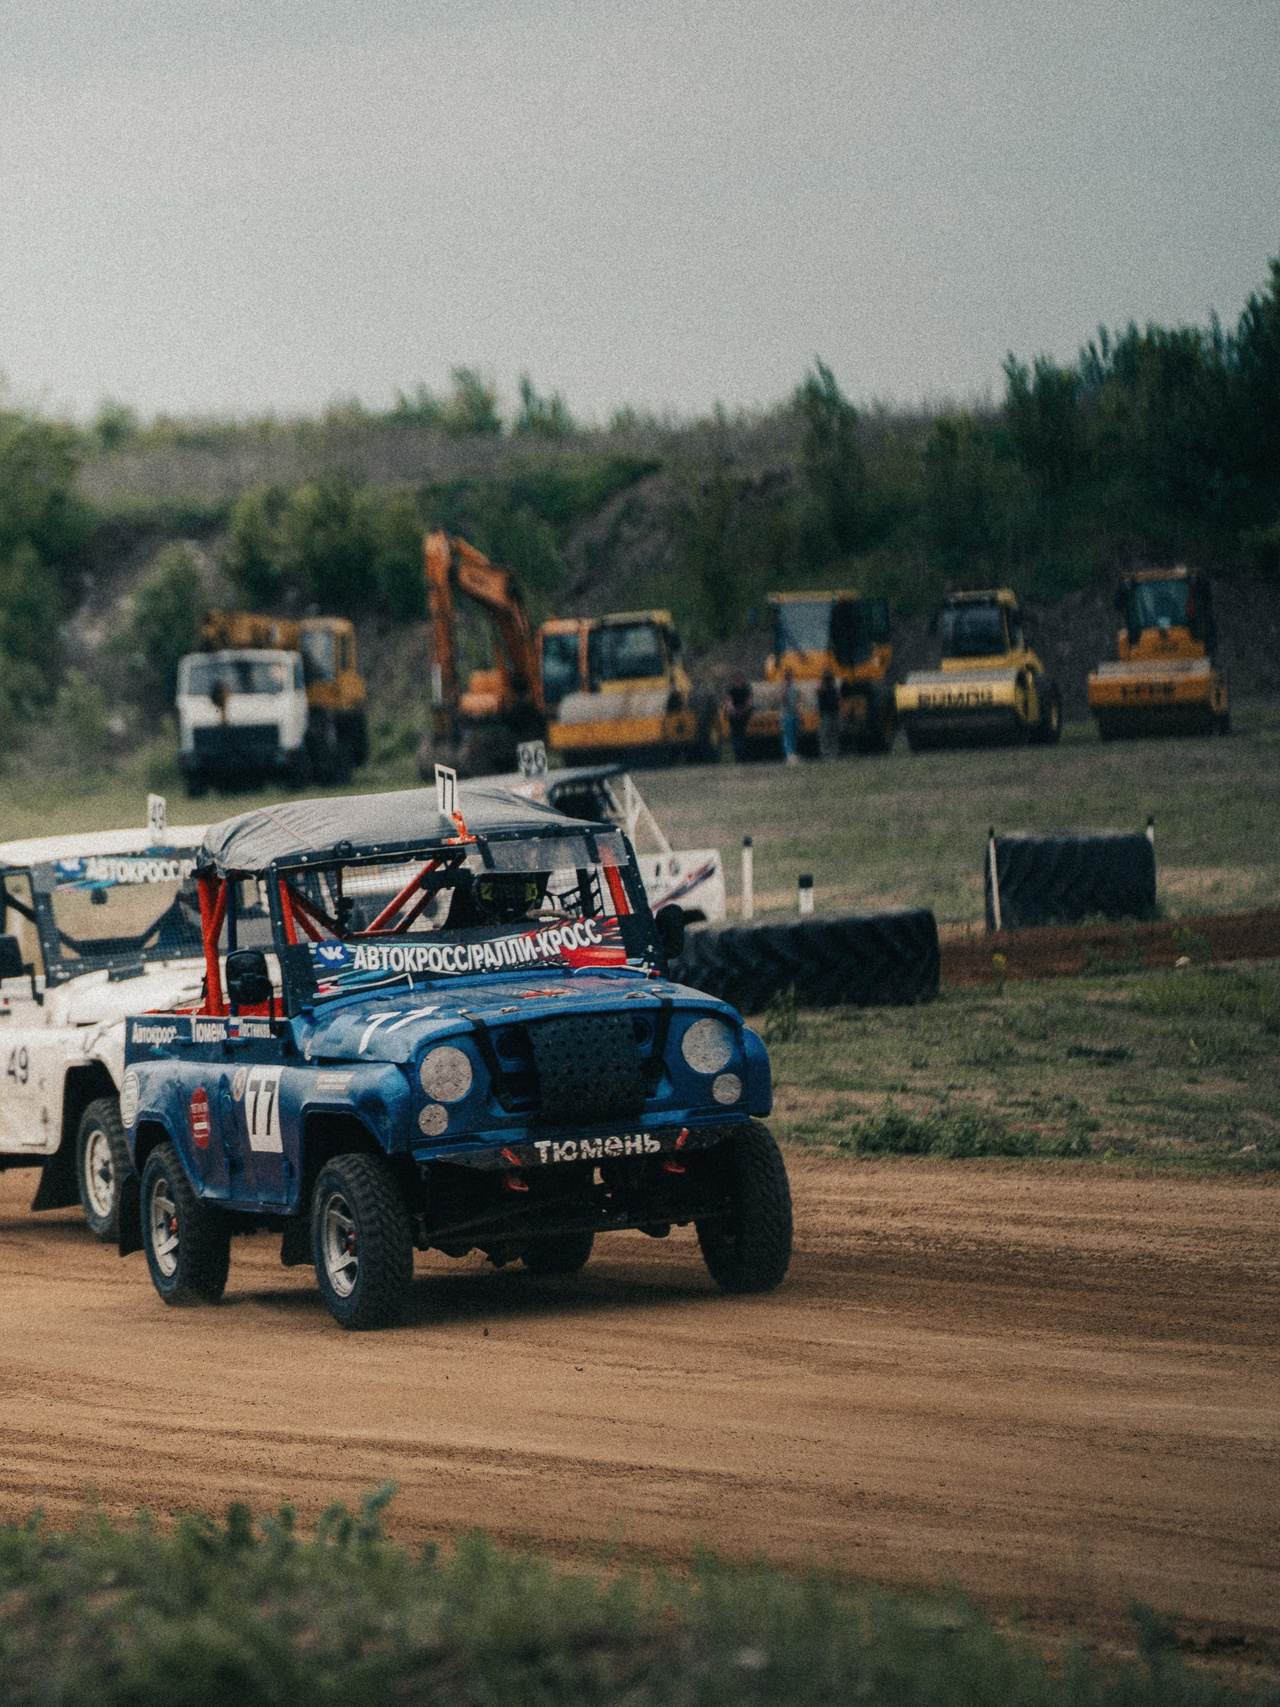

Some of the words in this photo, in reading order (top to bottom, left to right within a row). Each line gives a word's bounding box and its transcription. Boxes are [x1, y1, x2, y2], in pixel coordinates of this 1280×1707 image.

[437, 769, 454, 812] 77
[353, 919, 603, 972] АВТОКРОСС/РАЛЛИ-КРОСС
[7, 1046, 28, 1084] 49
[249, 1080, 277, 1135] 77
